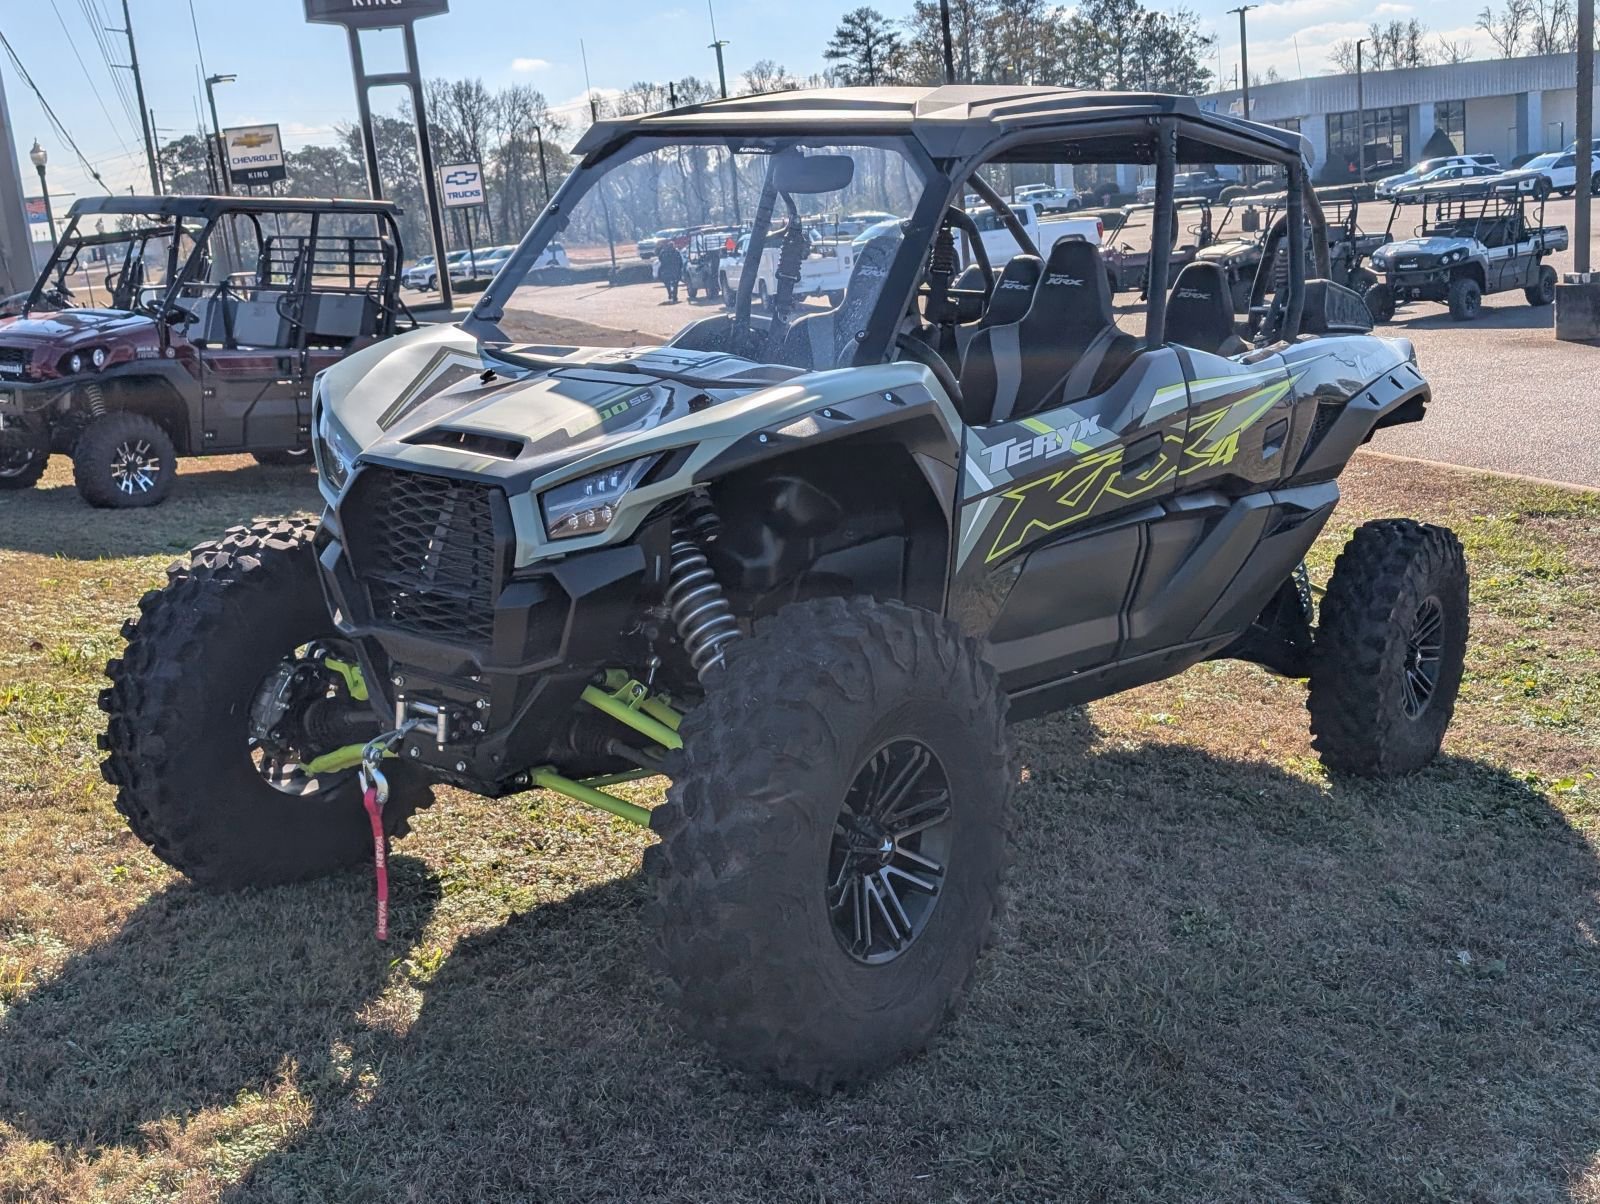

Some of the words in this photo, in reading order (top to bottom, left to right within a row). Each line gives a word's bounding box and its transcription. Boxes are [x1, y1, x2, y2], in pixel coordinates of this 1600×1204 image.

[232, 153, 279, 164] CHEVROLET
[247, 170, 269, 179] KING
[447, 189, 481, 199] TRUCKS
[629, 392, 652, 407] SE
[375, 835, 385, 868] WARN
[378, 900, 386, 933] WARN
